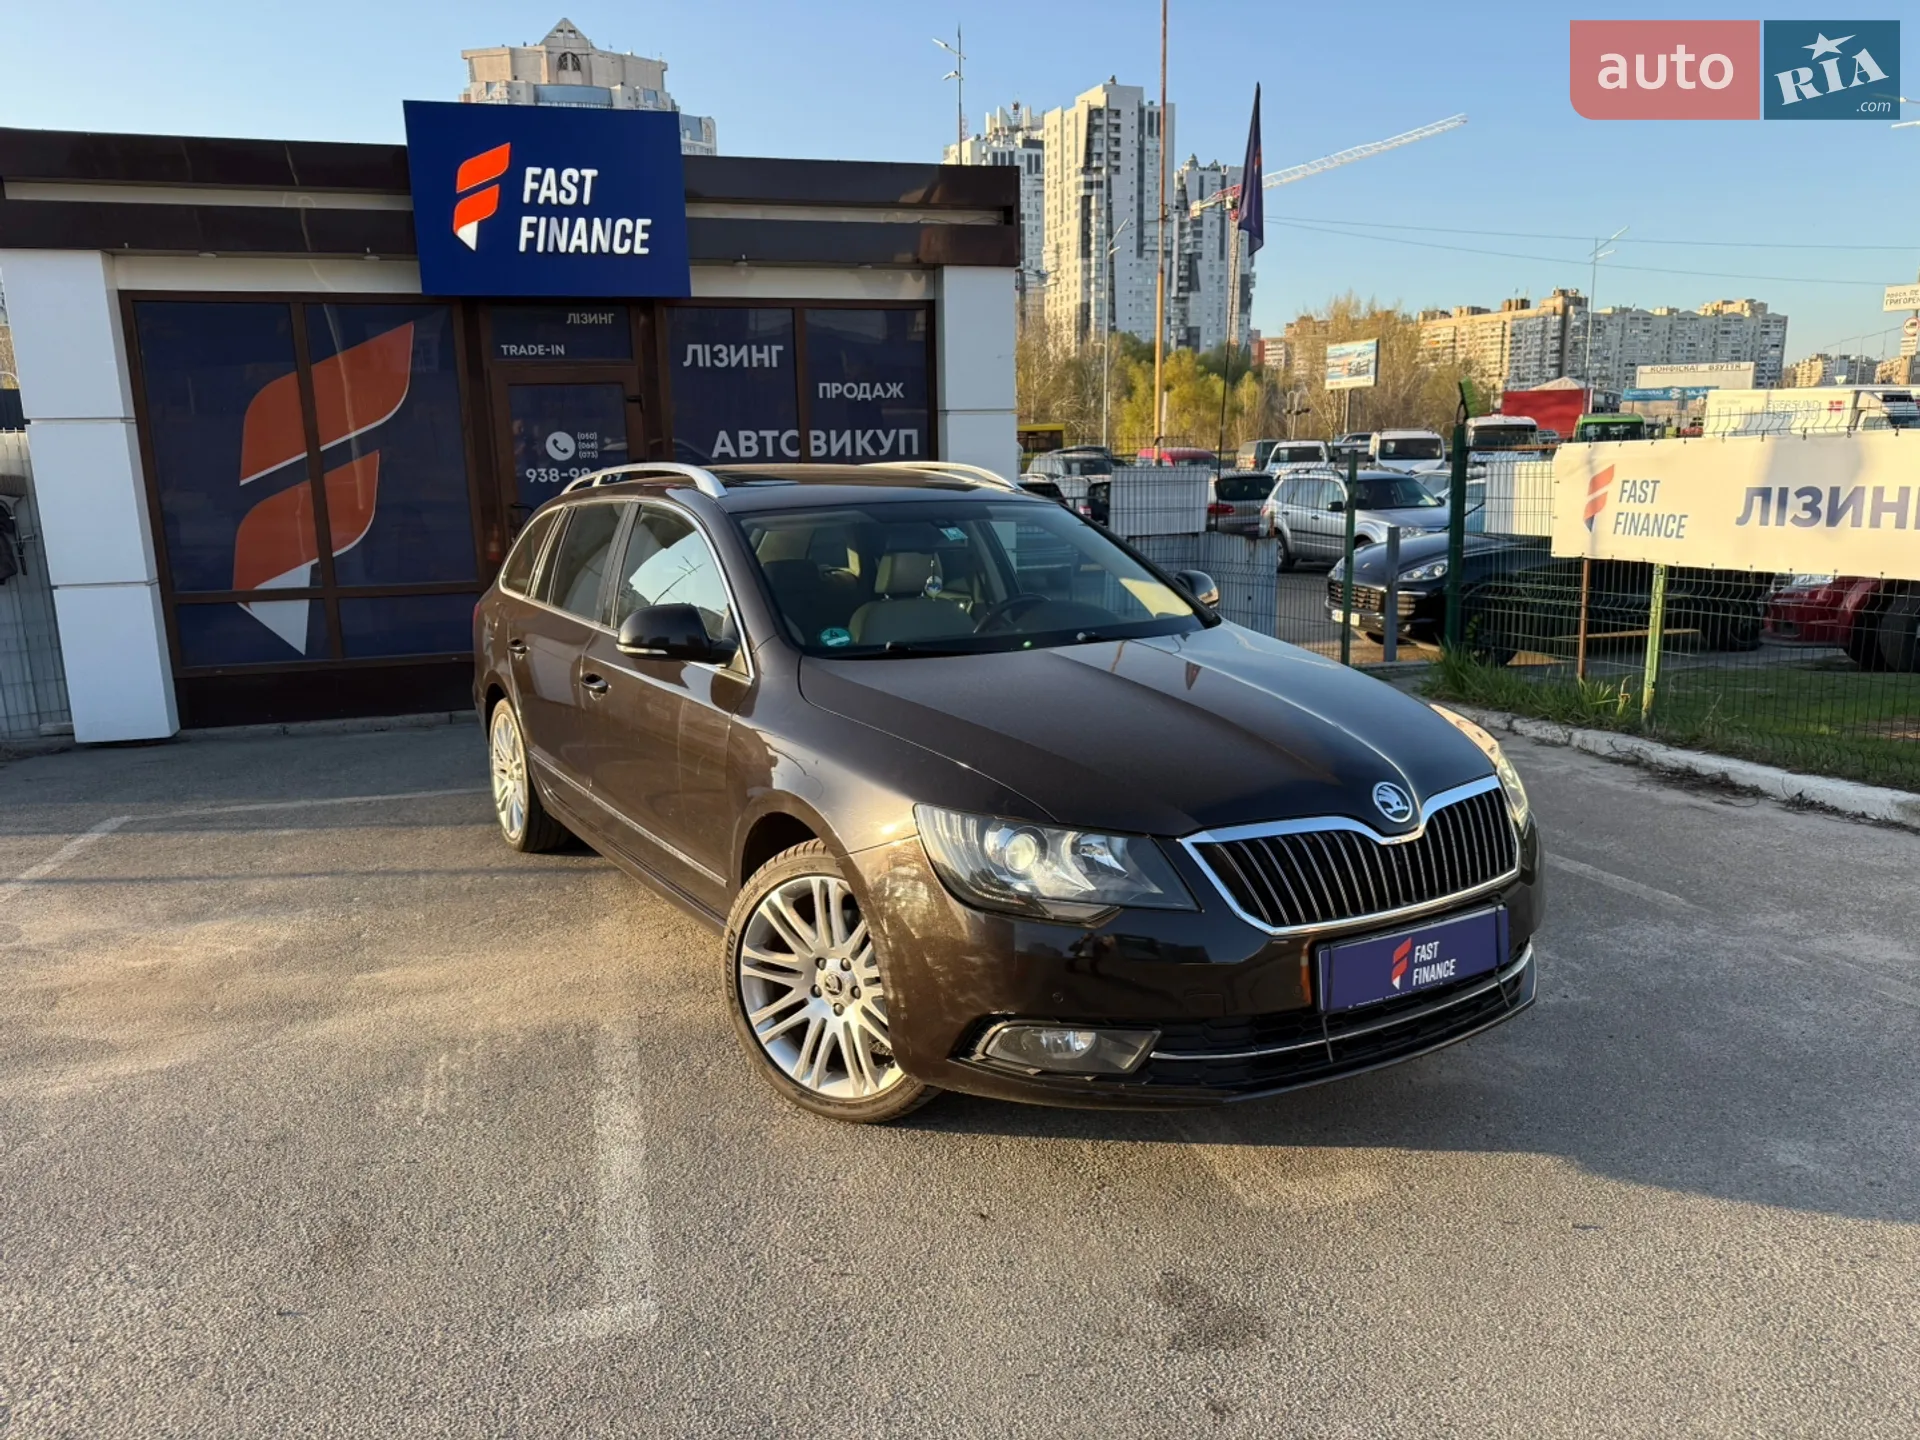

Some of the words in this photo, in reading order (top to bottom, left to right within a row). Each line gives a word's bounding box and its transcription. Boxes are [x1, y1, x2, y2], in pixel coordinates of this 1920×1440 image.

[522, 166, 599, 206] FAST
[518, 216, 652, 255] FINANCE
[566, 313, 615, 325] ЛІЗИНГ
[500, 344, 566, 356] TRADE-IN
[682, 344, 784, 368] ЛІЗИНГ
[818, 382, 905, 401] ПРОДАЖ
[577, 432, 598, 441] (050)
[578, 450, 599, 459] (073)
[1618, 480, 1661, 504] FAST
[1735, 485, 1920, 531] ЛІЗИН
[1613, 512, 1689, 540] FINANCE
[1414, 941, 1440, 964] FAST
[1412, 958, 1457, 987] FINANCE
